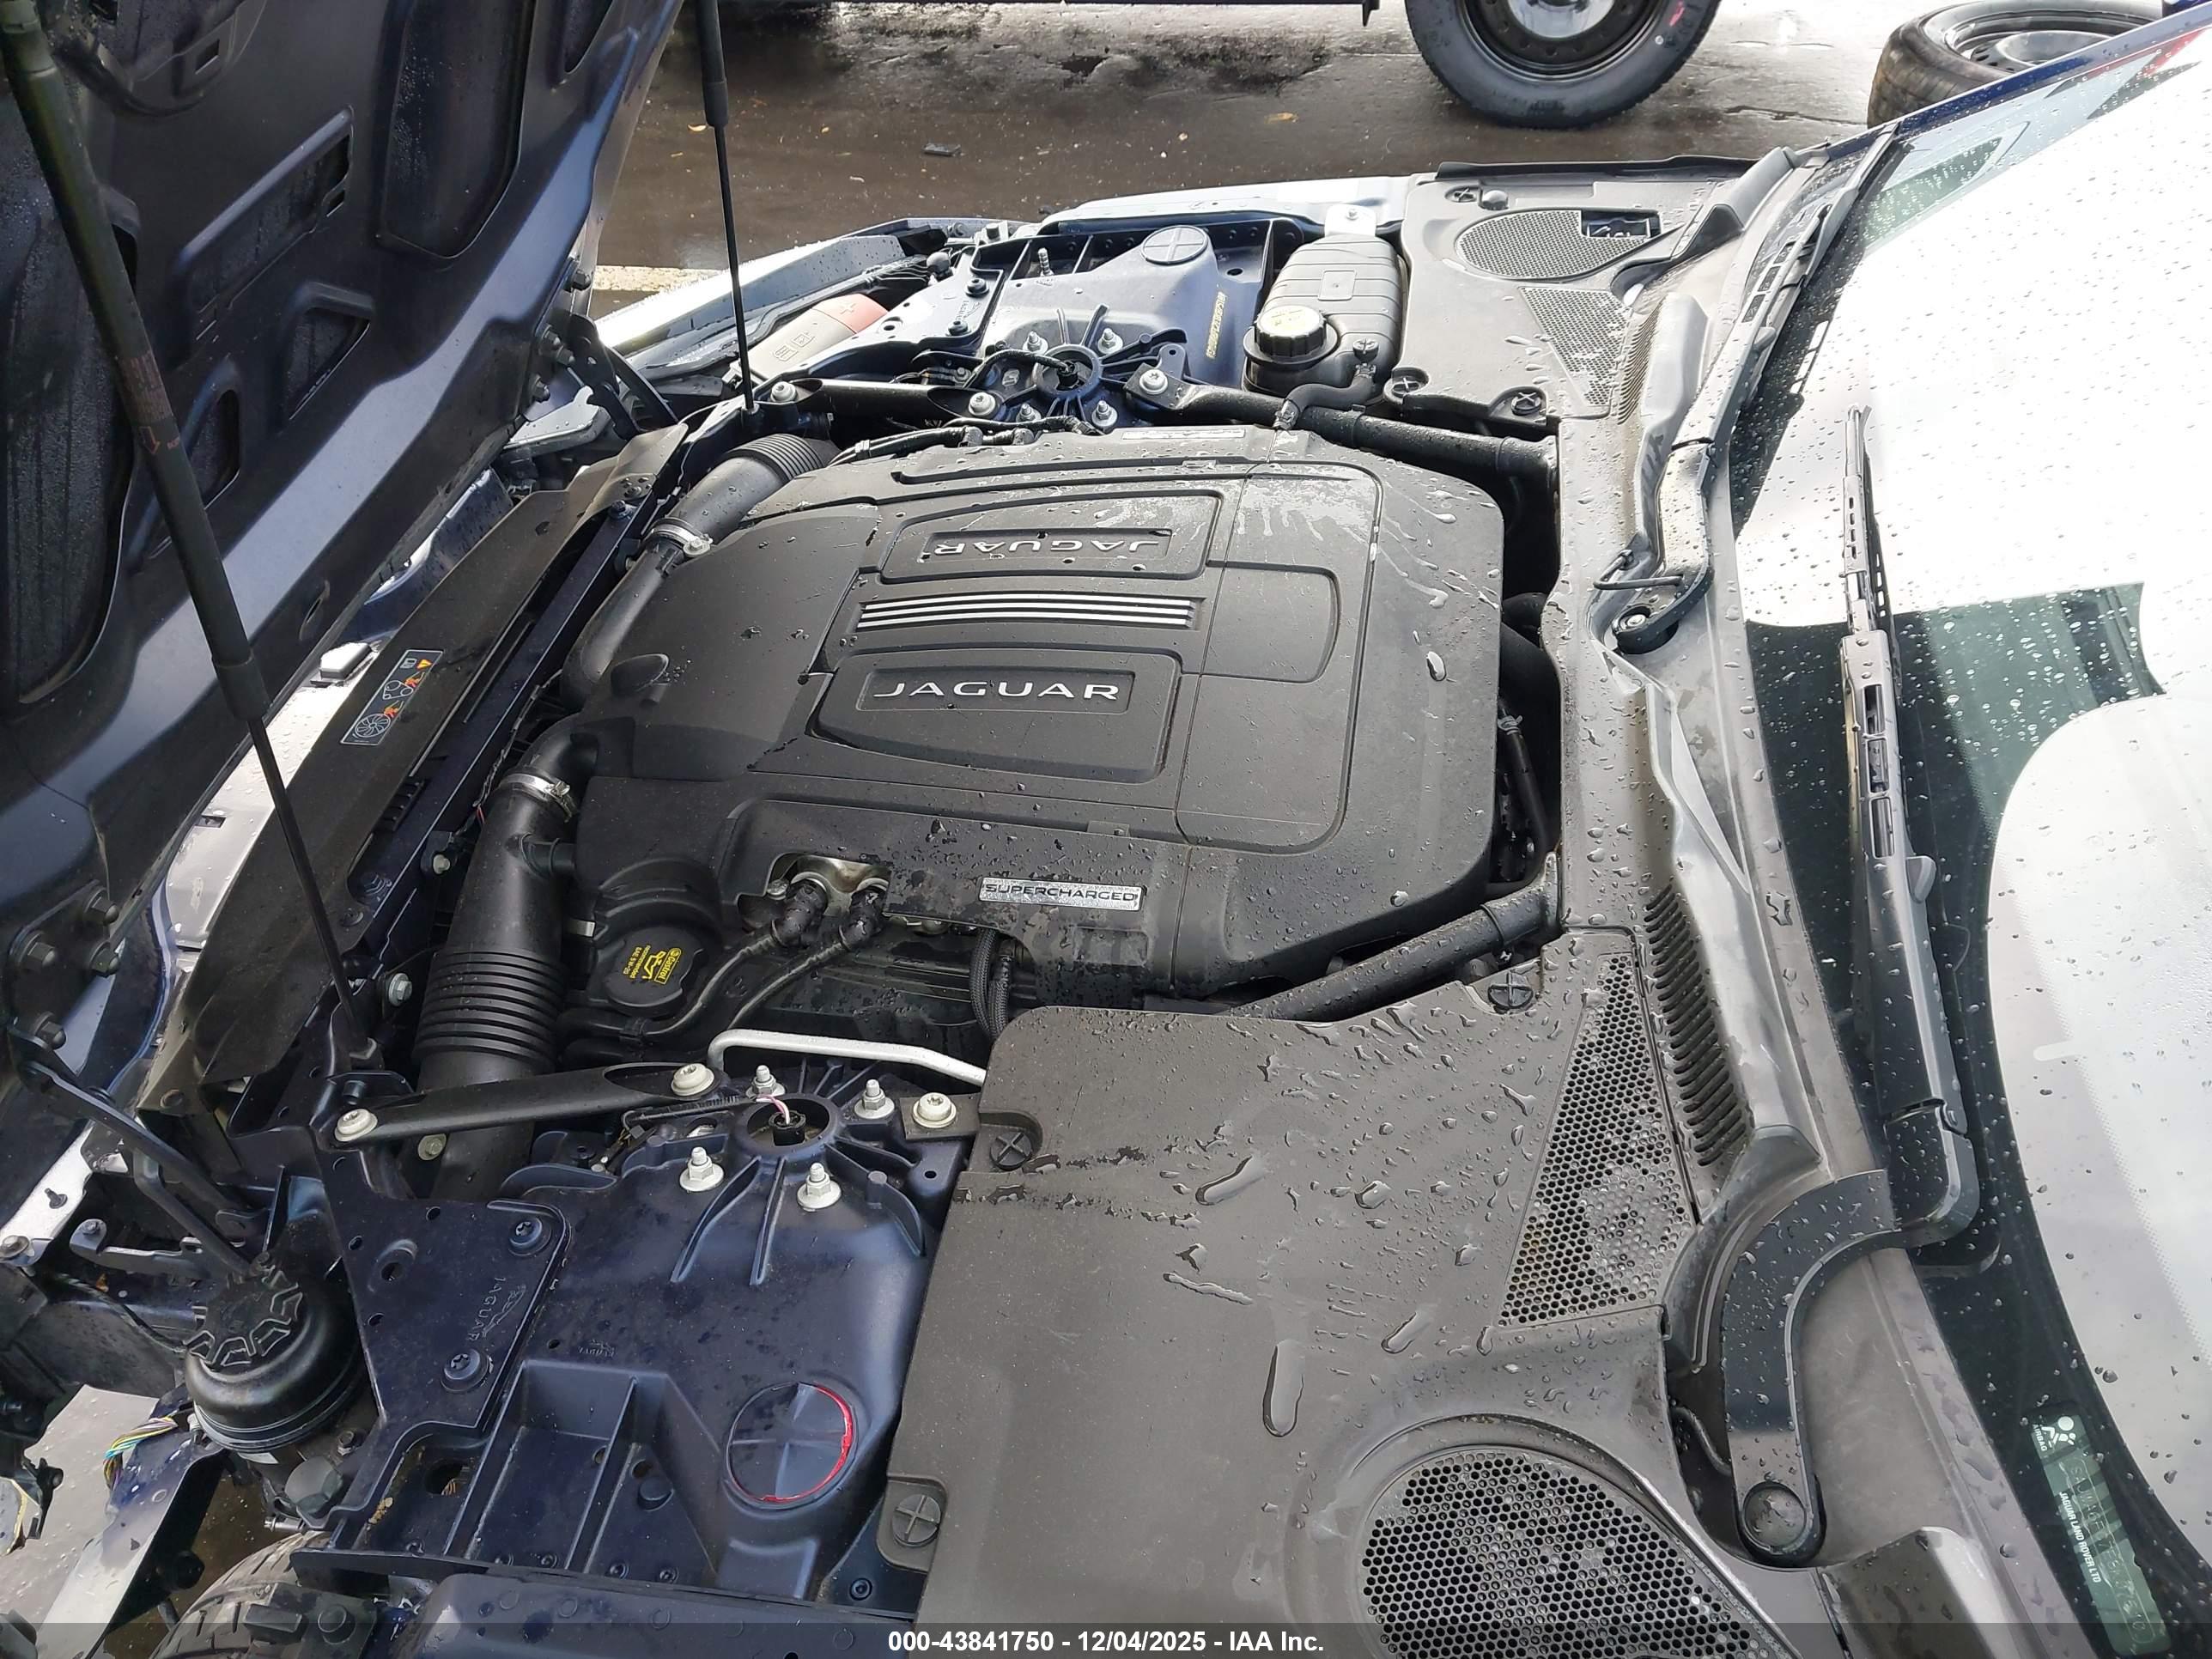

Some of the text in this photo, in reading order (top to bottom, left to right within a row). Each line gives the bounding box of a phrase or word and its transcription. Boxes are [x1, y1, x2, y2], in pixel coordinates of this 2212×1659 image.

[934, 539, 1161, 556] JAGUAR
[873, 681, 1119, 701] JAGUAR
[984, 883, 1137, 902] SUPERCHARGED
[629, 945, 651, 978] recommended
[658, 957, 676, 980] Castrol
[465, 1276, 507, 1341] JAGUAR
[2032, 1424, 2048, 1452] AIRBAG
[2058, 1490, 2101, 1583] JAGUAR LAND ROVER LTD
